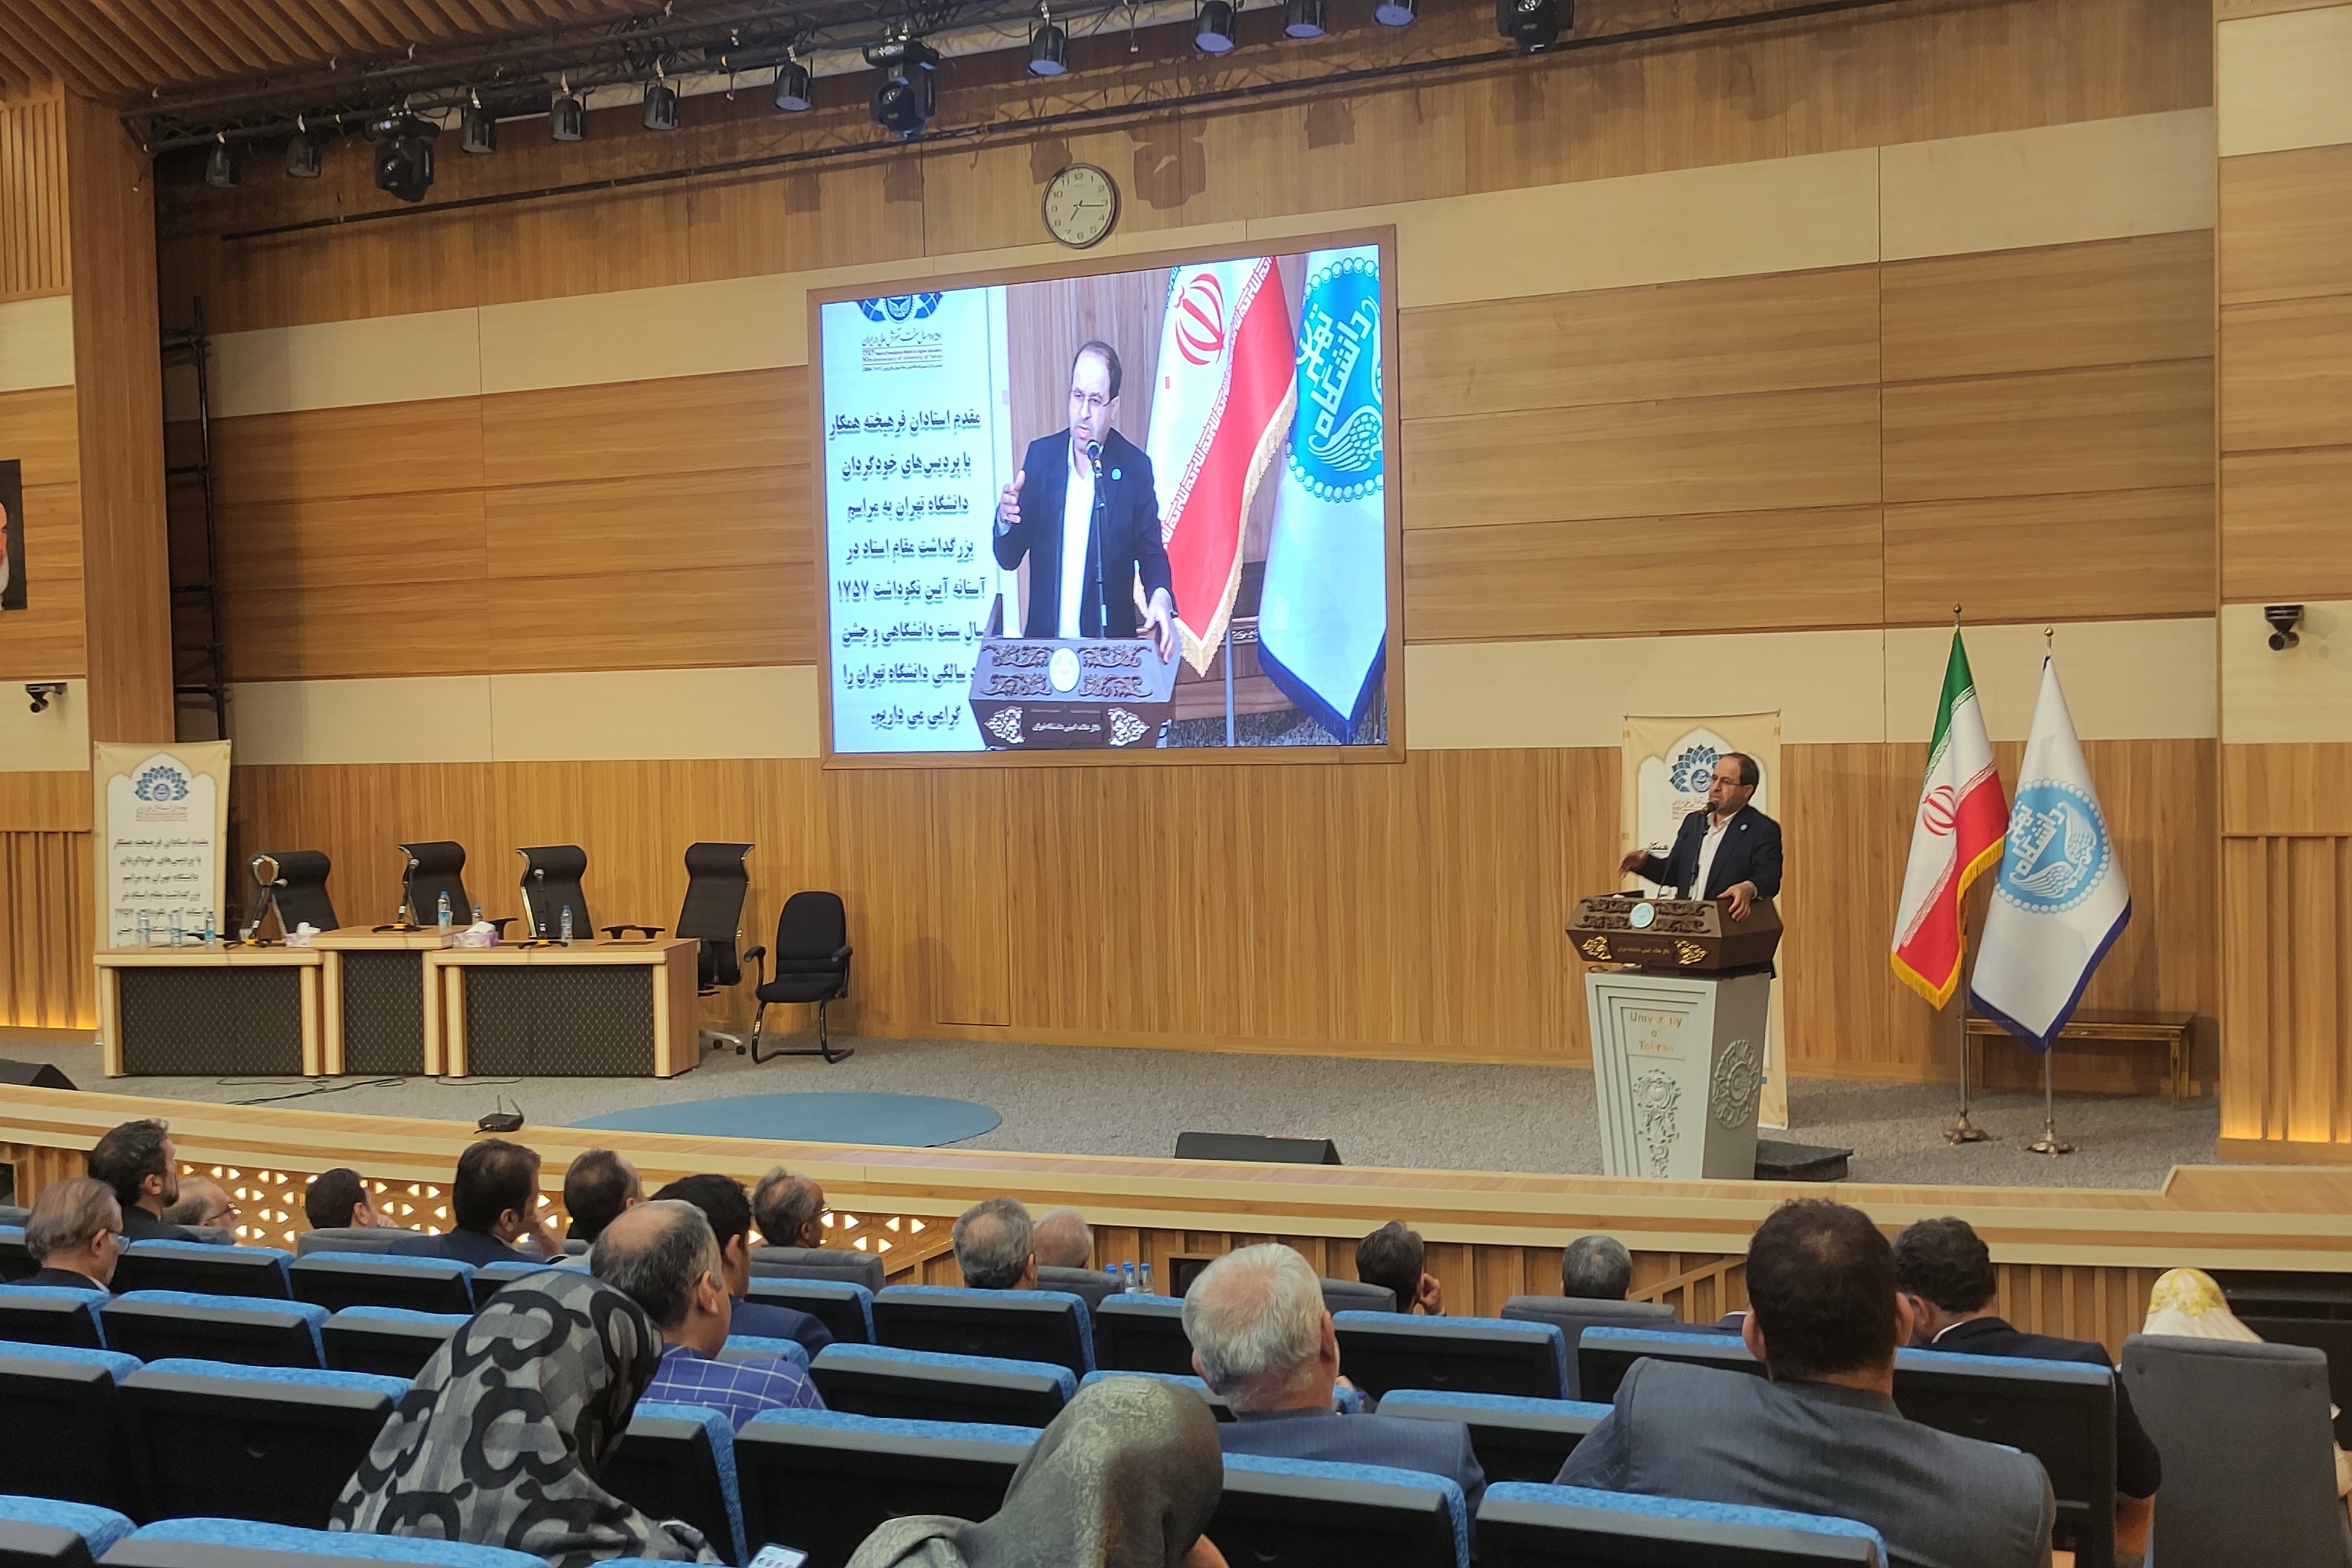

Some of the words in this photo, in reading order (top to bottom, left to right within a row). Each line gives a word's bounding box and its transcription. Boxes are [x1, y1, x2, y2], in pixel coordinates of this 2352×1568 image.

[828, 414, 860, 436] همکار
[910, 409, 950, 432] استادان
[954, 408, 981, 430] مقدم
[842, 454, 897, 478] خودگردان
[847, 497, 879, 519] مراسم
[882, 500, 892, 516] به
[896, 495, 925, 517] تهران
[928, 495, 969, 512] دانشگاه
[846, 542, 859, 562] در
[862, 537, 889, 555] استاد
[893, 537, 915, 558] مقام
[918, 537, 973, 559] بزرگداشت
[837, 580, 869, 600] ۱۷۵۷
[842, 623, 868, 644] جشن
[843, 663, 853, 685] را
[856, 663, 886, 685] تهران
[888, 663, 929, 679] دانشگاه
[906, 710, 924, 726] می
[927, 705, 962, 727] گرامی
